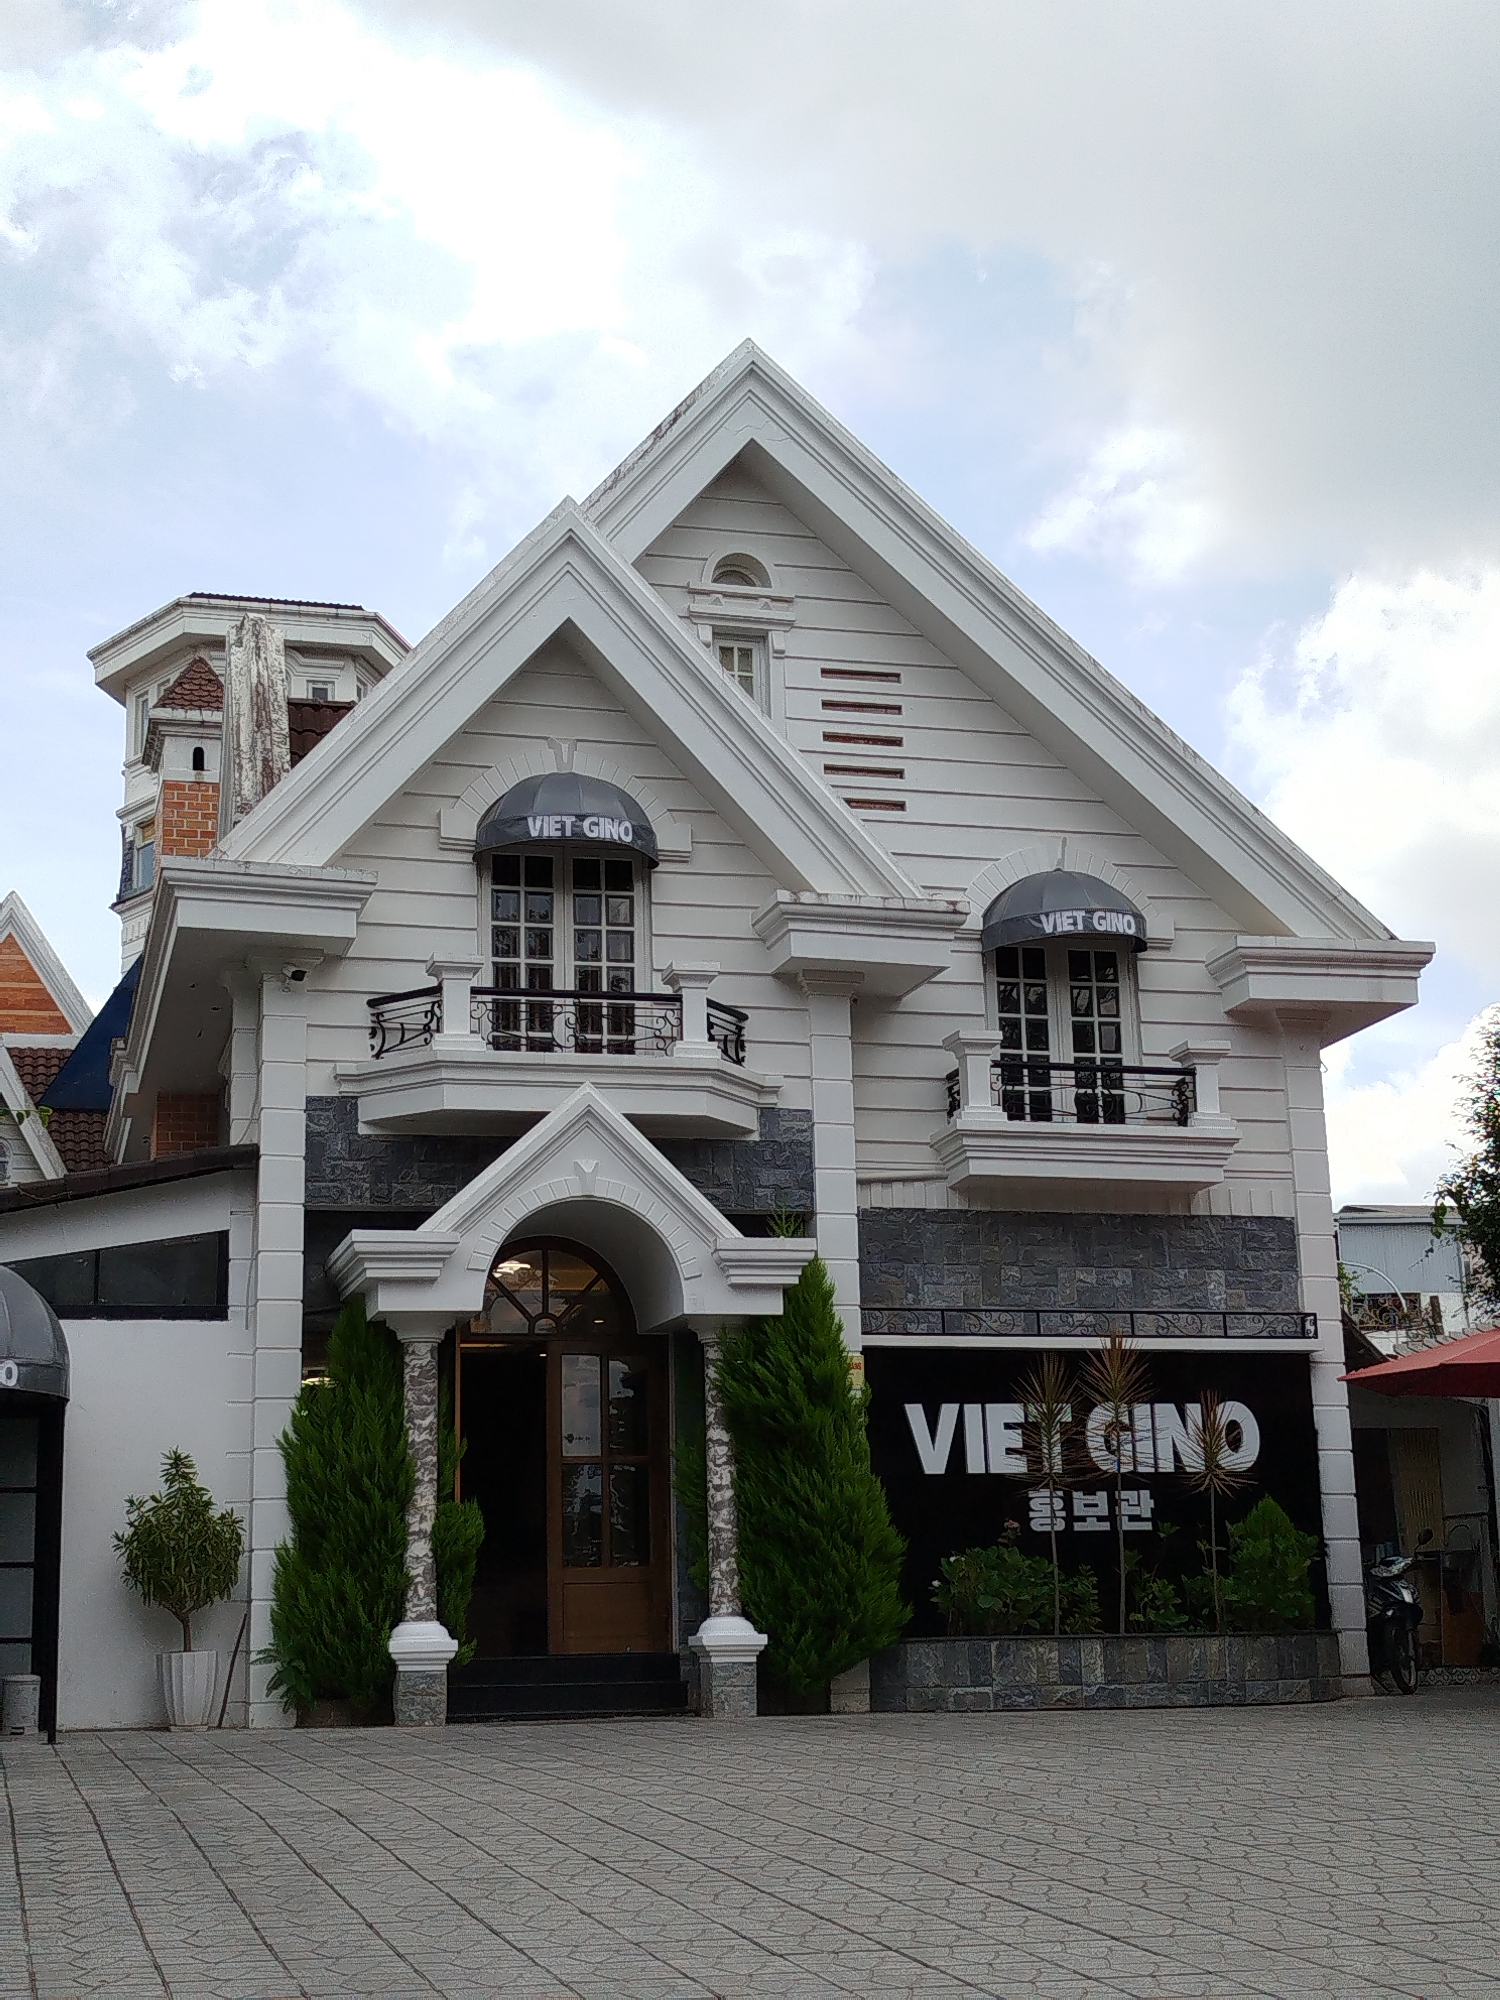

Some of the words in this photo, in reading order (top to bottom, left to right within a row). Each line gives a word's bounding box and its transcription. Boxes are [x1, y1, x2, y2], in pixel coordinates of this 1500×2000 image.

[527, 815, 576, 838] VIET
[582, 816, 633, 843] GINO
[1039, 909, 1086, 934] VIET
[1092, 910, 1136, 935] GINO
[904, 1402, 1072, 1475] VIET
[1085, 1400, 1261, 1474] GINO
[1027, 1488, 1155, 1532] 홍보관
